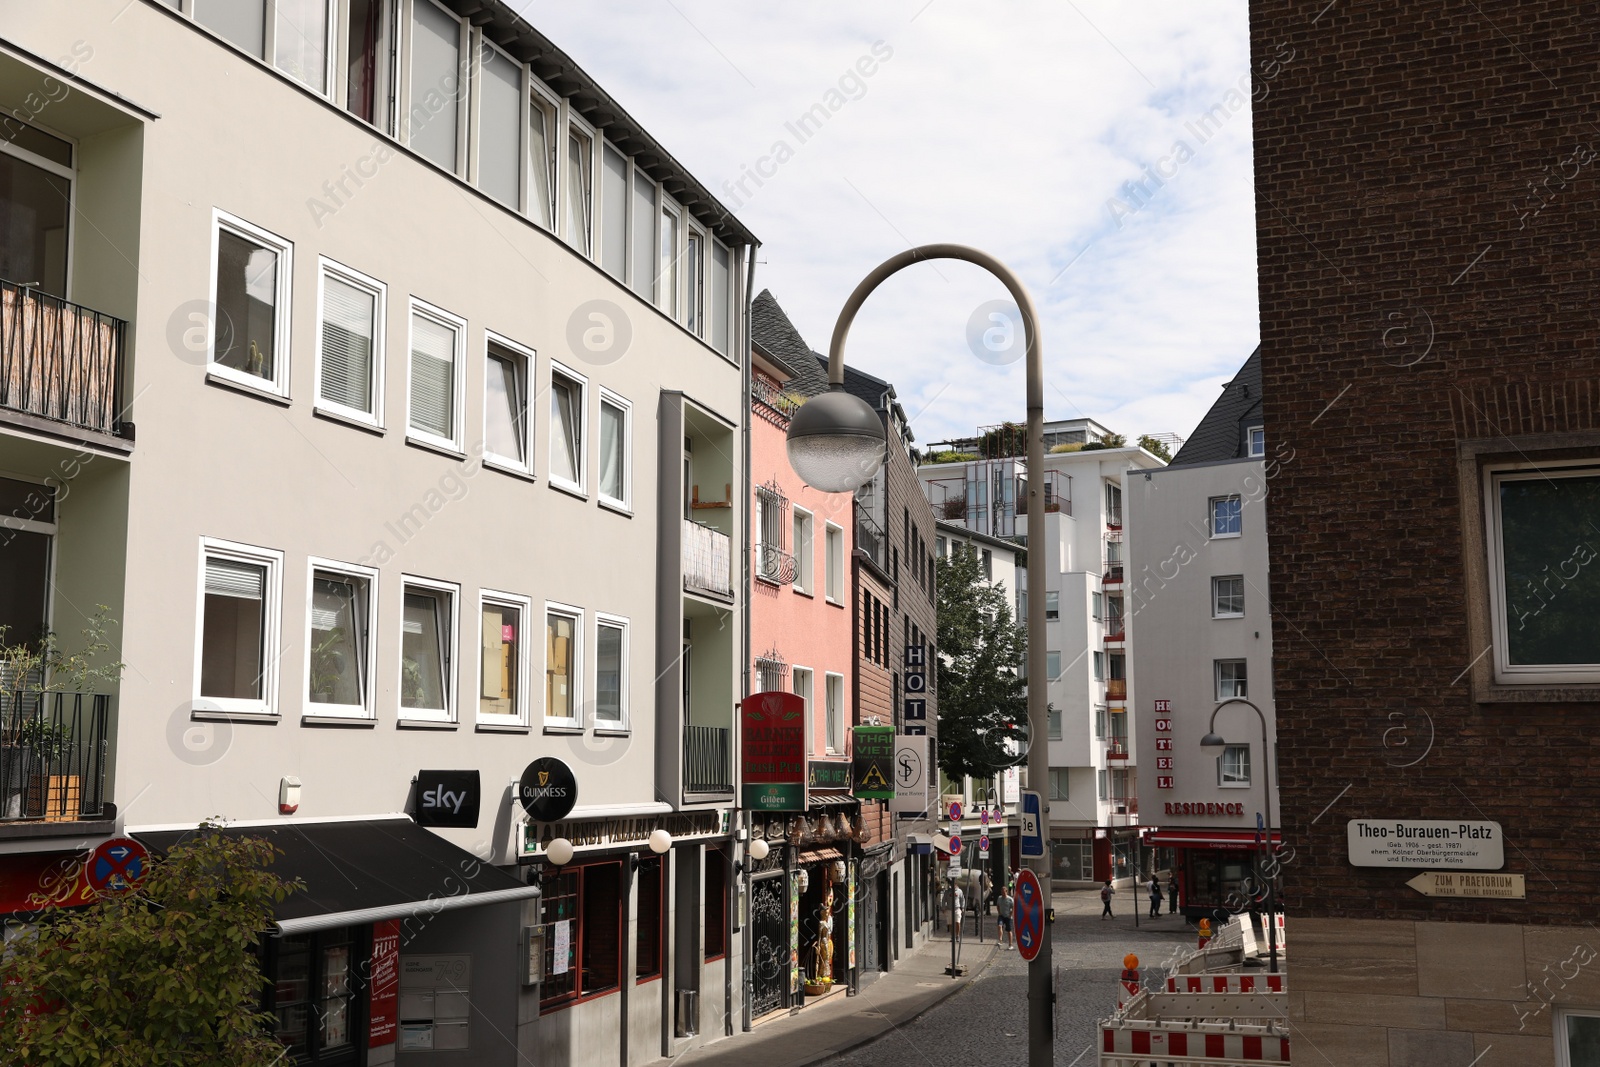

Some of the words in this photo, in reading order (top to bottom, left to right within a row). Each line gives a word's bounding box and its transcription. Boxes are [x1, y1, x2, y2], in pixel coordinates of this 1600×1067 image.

[746, 727, 801, 742] BARNEY
[857, 735, 892, 743] THAI
[857, 746, 892, 754] VIET
[1156, 701, 1168, 788] HOTEL
[423, 784, 467, 814] sky
[523, 786, 567, 798] GUINNESS
[760, 795, 785, 804] Gilden
[1164, 802, 1245, 816] RESIDENCE
[555, 820, 605, 847] BARNEY
[666, 814, 693, 837] IRISH
[693, 813, 712, 836] PUB
[1357, 823, 1492, 840] Theo-Burauen-Platz
[1401, 856, 1441, 864] Ehrenbürger
[1416, 849, 1479, 857] Oberbürgermeister
[1434, 874, 1453, 887] ZUM
[1460, 875, 1513, 888] PRAETORIUM
